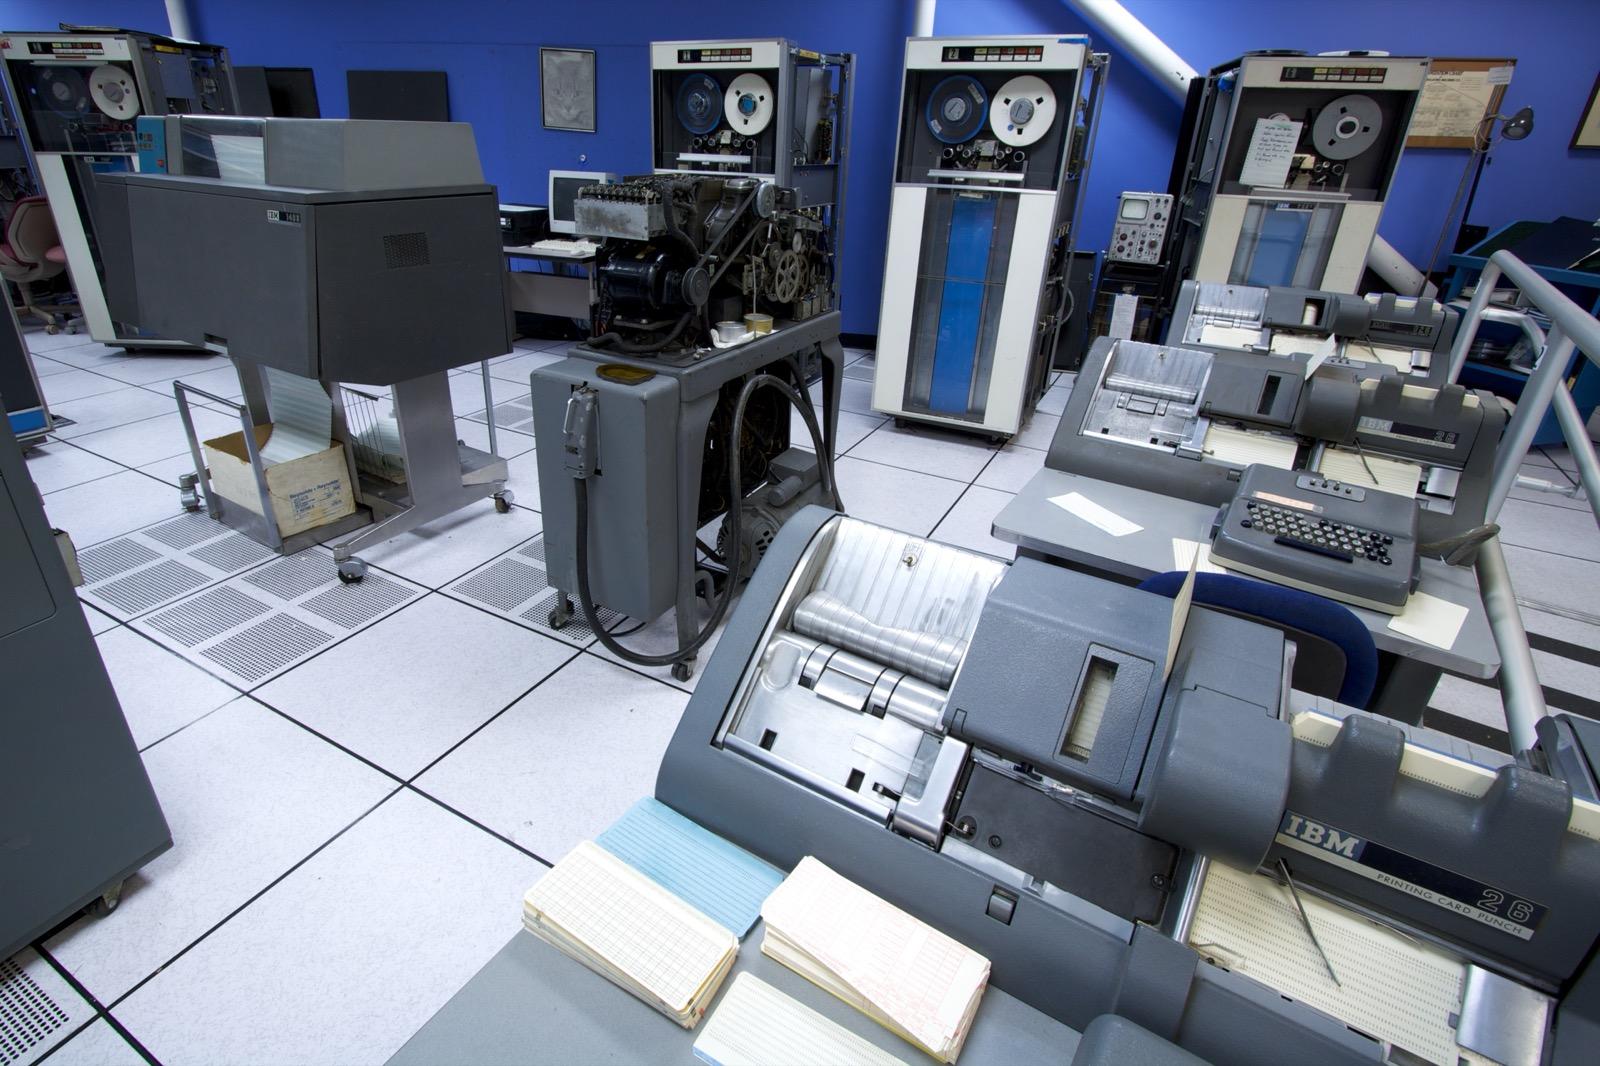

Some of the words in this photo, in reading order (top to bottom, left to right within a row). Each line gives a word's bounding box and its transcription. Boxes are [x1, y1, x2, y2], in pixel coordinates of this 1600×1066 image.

[1284, 815, 1360, 859] IBM
[1476, 888, 1535, 924] 26
[1376, 873, 1434, 899] PRINTING
[1437, 896, 1472, 915] CARD
[1477, 912, 1523, 935] PUNCH
